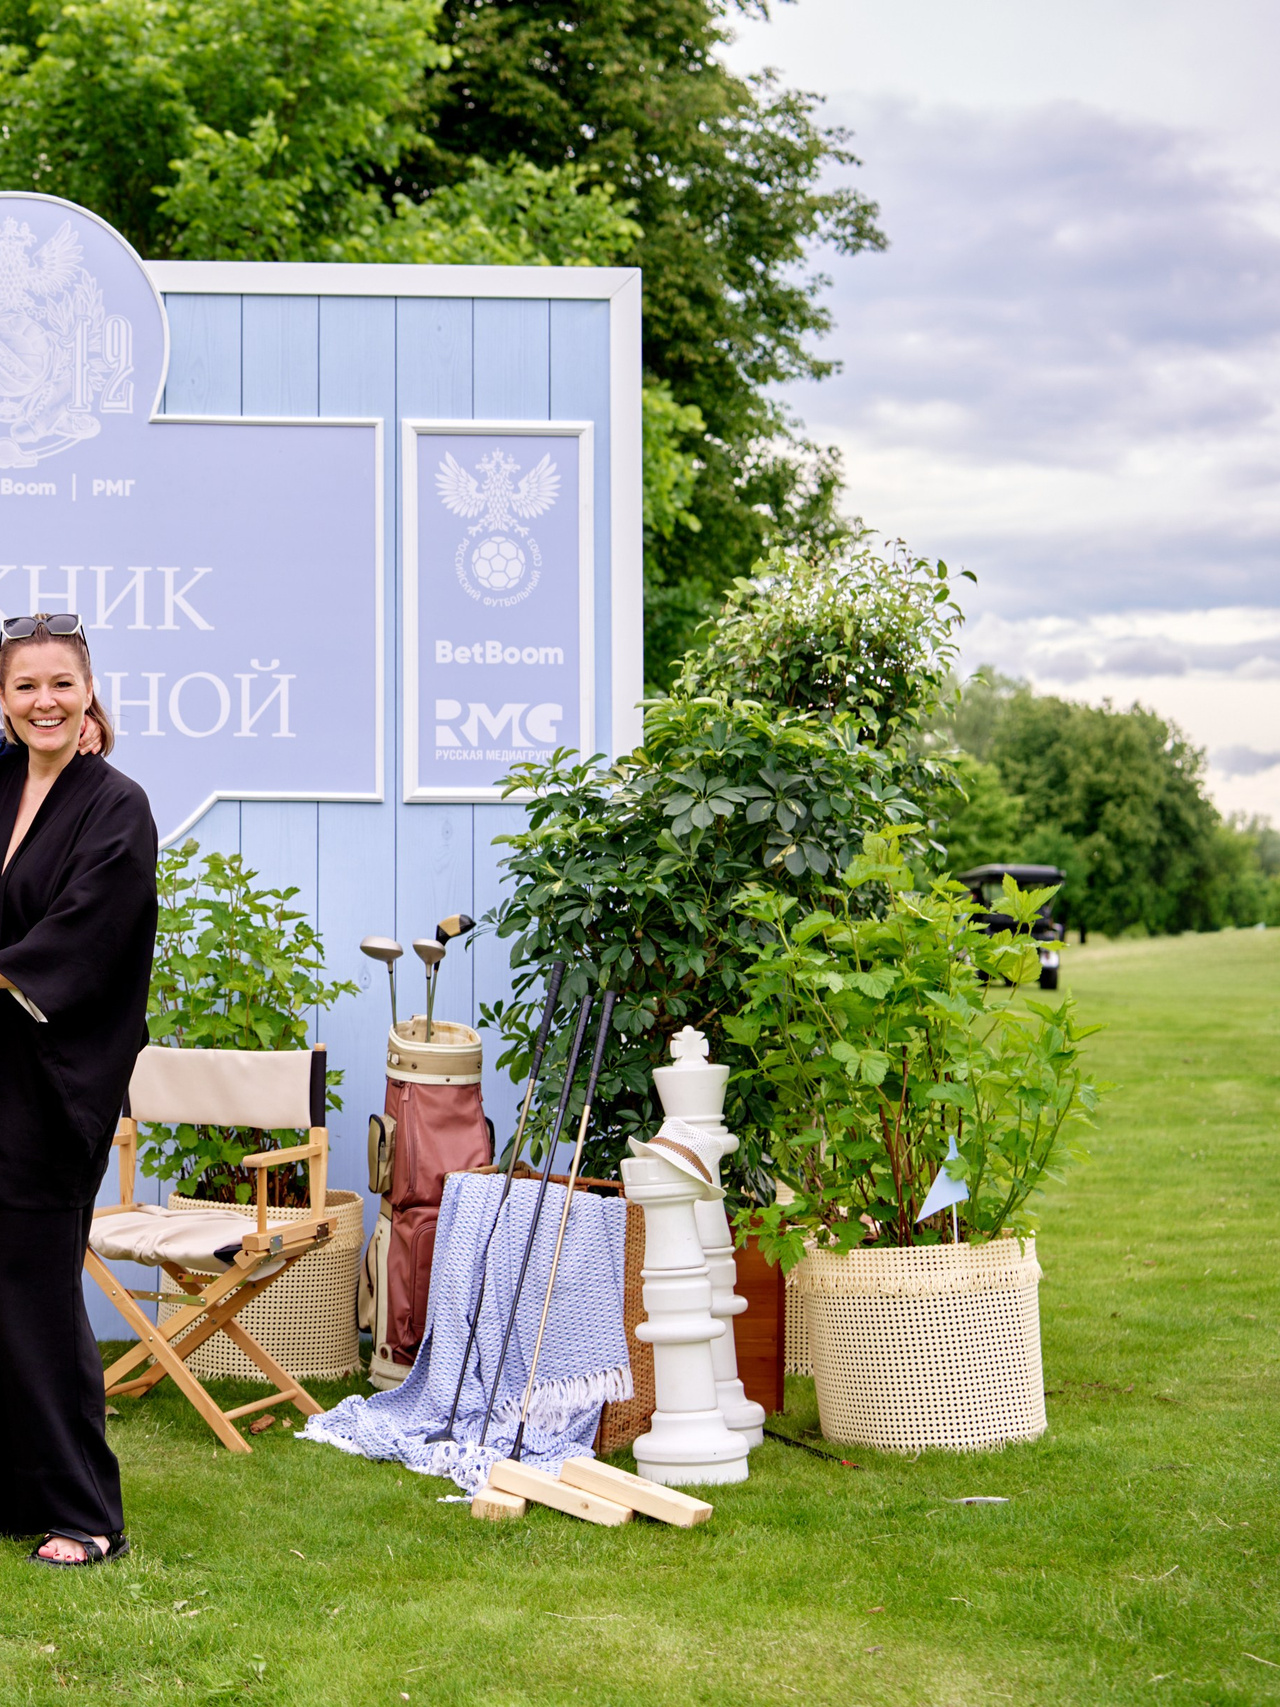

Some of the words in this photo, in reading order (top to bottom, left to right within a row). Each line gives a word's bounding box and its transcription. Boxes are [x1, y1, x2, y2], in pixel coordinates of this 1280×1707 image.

[59, 315, 135, 414] 12
[92, 479, 136, 497] РМГ
[455, 537, 482, 602] РОССИЙСКИЙ
[483, 570, 542, 608] ФУТБОЛЬНЫЙ
[527, 537, 543, 567] СОЮЗ
[435, 640, 565, 665] BetBoom
[435, 699, 563, 748] RMG
[435, 750, 483, 762] РУССКАЯ
[486, 750, 555, 763] МЕДИАГРУП
